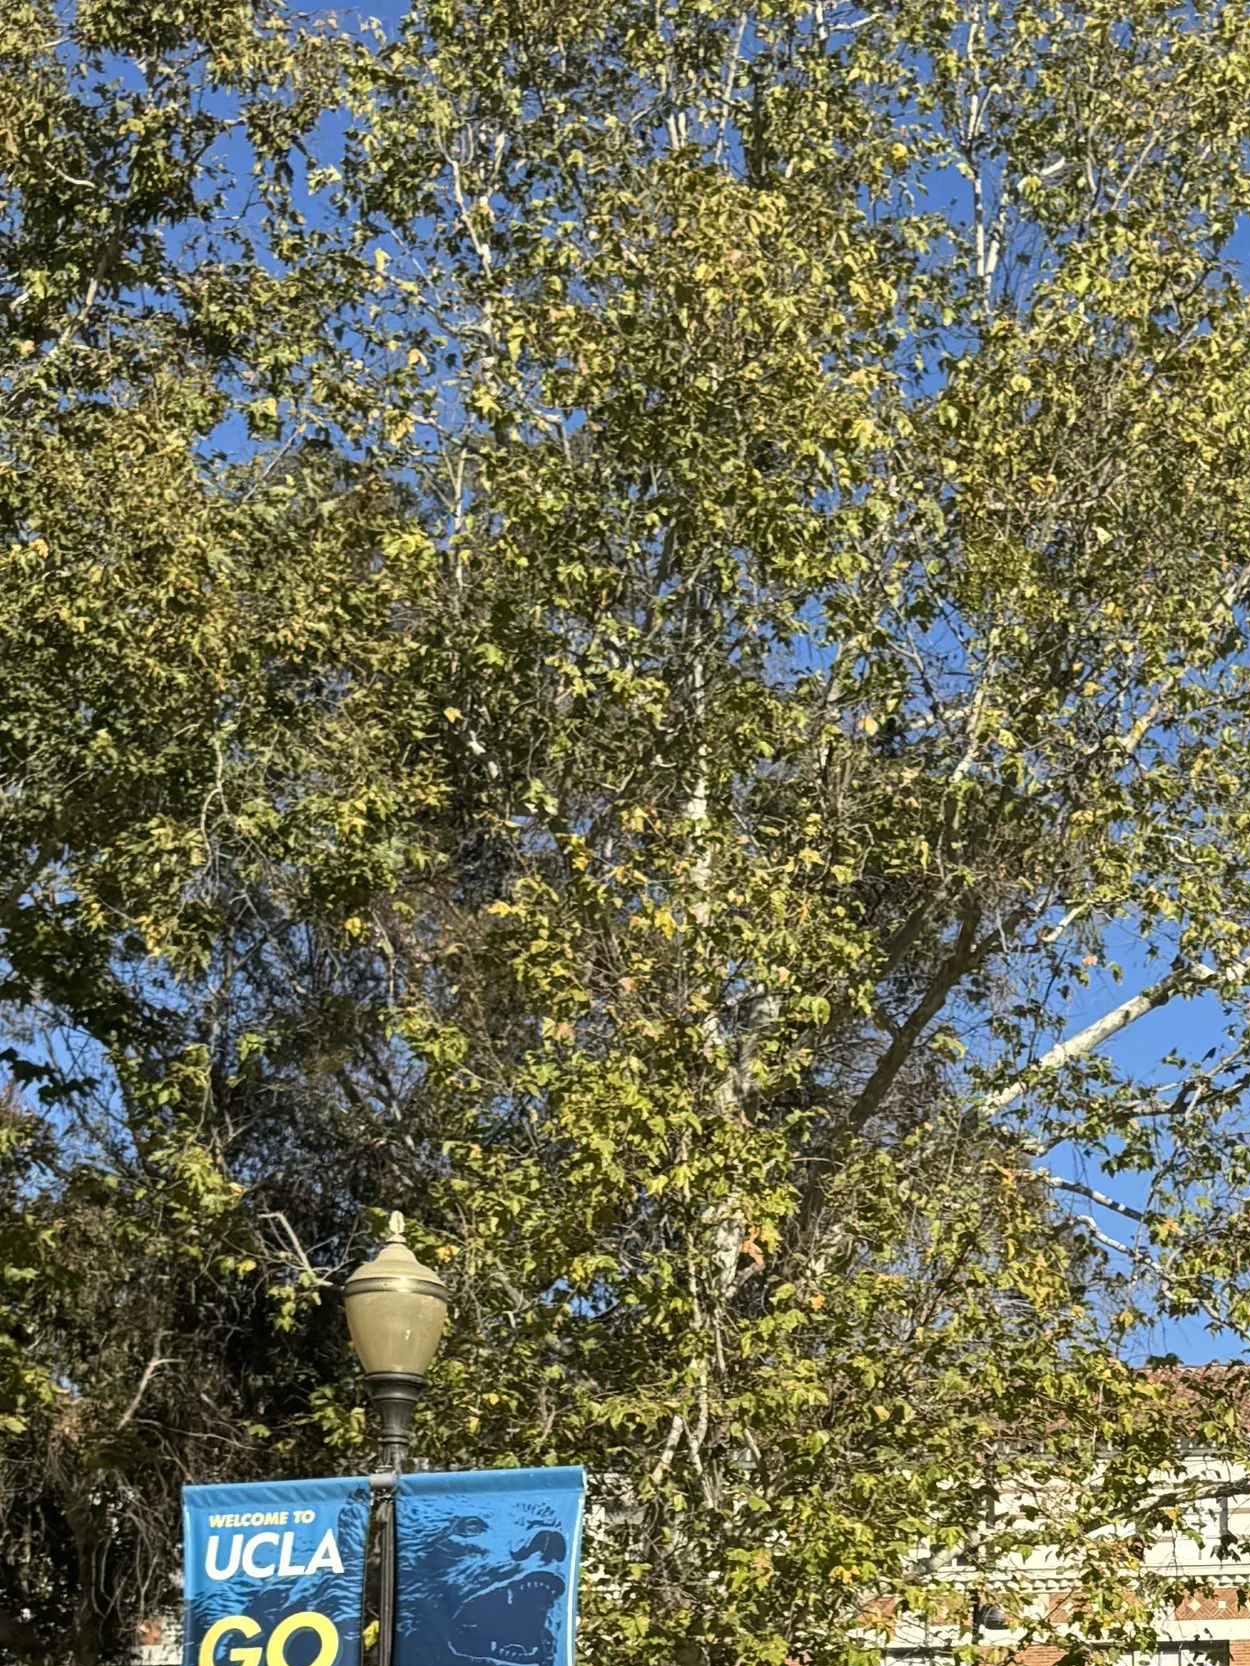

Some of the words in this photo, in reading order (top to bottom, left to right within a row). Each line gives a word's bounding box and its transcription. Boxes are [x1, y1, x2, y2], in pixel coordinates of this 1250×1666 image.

[208, 1511, 289, 1528] WELCOME
[293, 1509, 316, 1525] TO
[205, 1528, 345, 1580] UCLA
